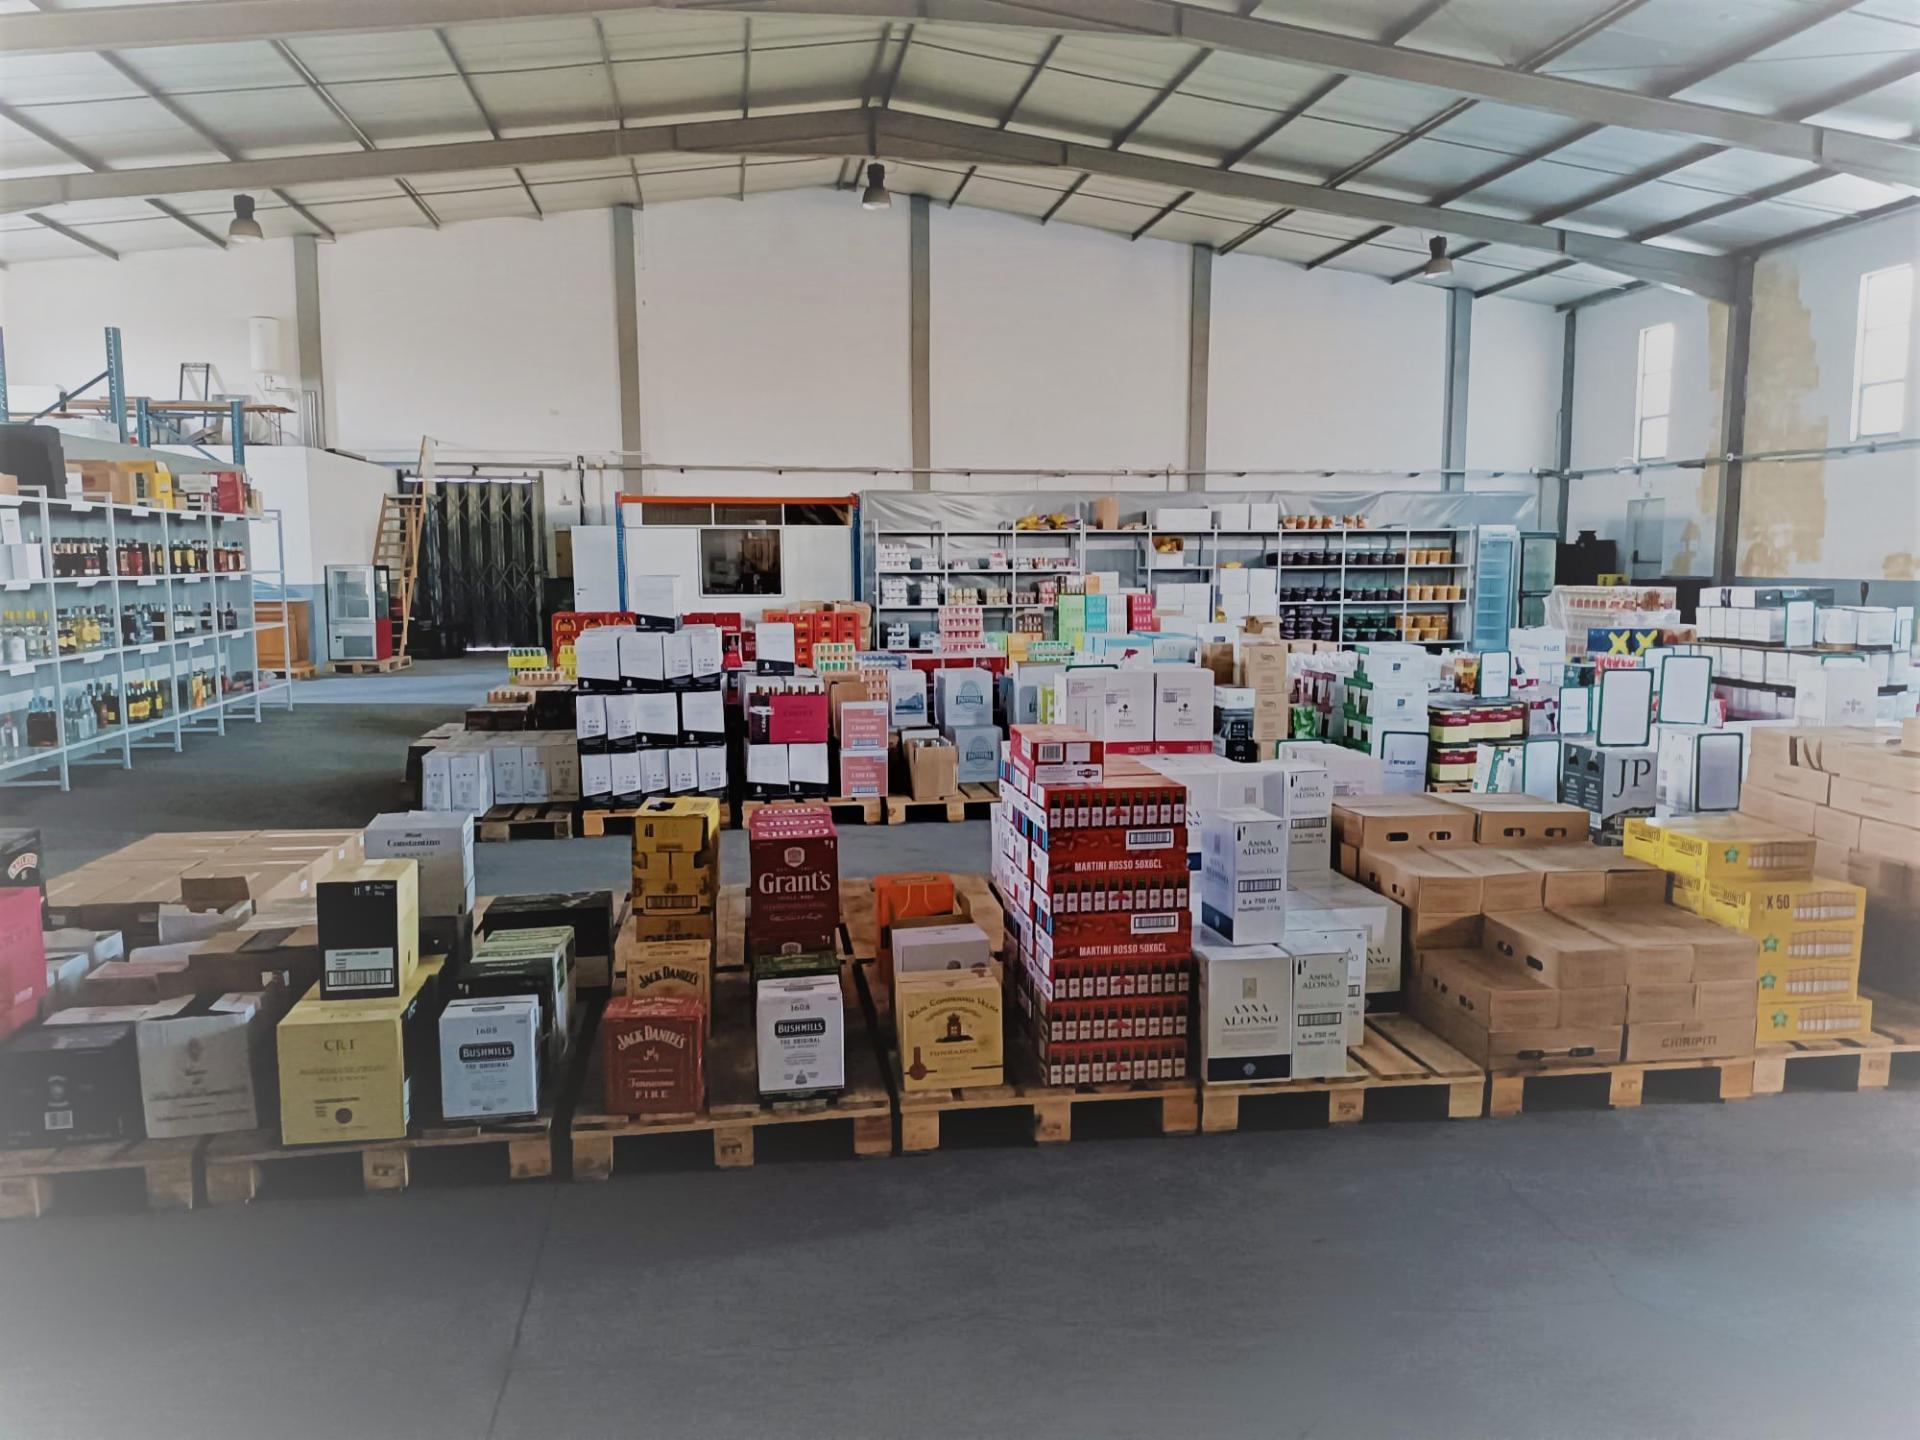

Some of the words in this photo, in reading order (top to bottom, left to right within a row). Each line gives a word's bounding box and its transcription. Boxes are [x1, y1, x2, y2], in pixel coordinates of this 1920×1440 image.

[1612, 759, 1651, 798] JP
[1242, 847, 1279, 855] ALONSO
[1074, 861, 1107, 872] MARTINI
[1109, 860, 1133, 870] ROSSO
[758, 870, 832, 894] Grant's
[1080, 946, 1111, 956] MARTINI
[1113, 945, 1137, 954] ROSSO
[639, 970, 662, 989] JACK
[1302, 980, 1340, 989] ALONSO
[1233, 1003, 1268, 1014] ANNA
[1224, 1014, 1279, 1026] ALONSO
[777, 1022, 824, 1034] BUSHMILLS
[616, 1029, 645, 1050] JACK
[644, 1025, 686, 1049] DANIEL'S
[462, 1046, 512, 1058] BUSHMILLS
